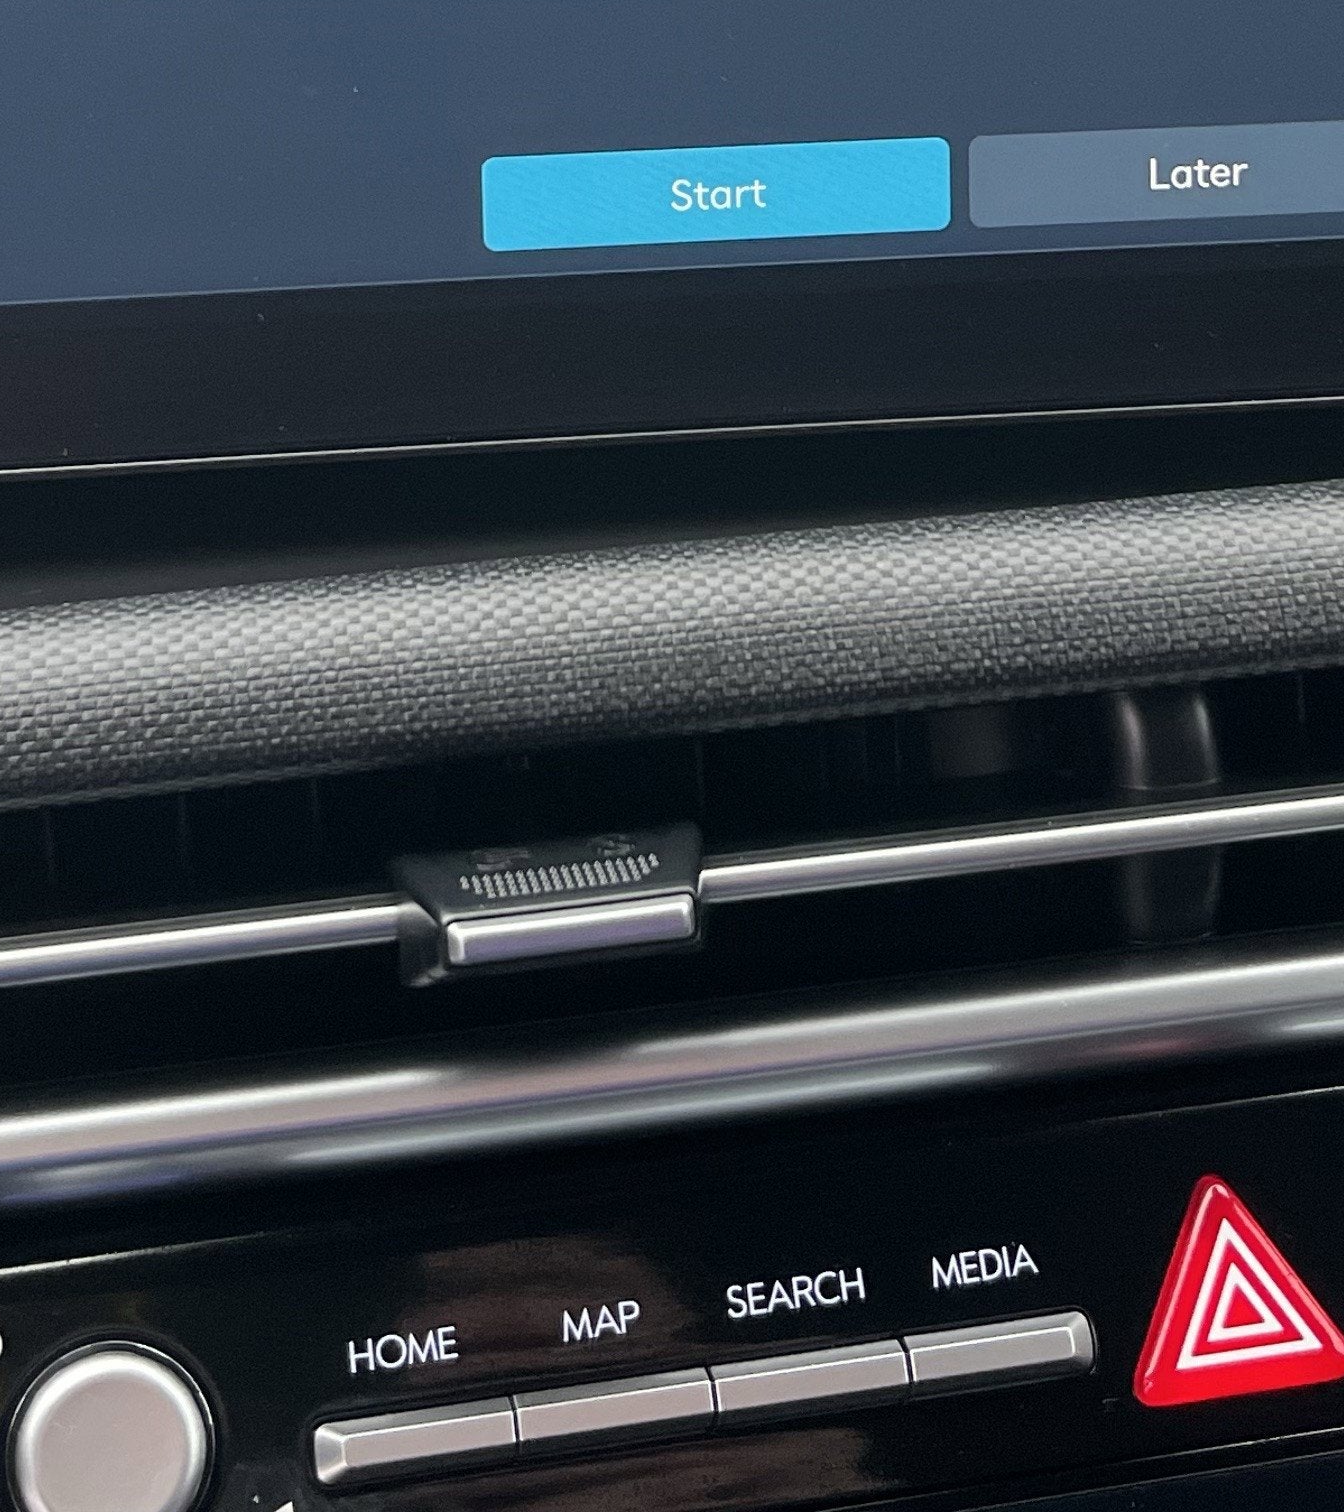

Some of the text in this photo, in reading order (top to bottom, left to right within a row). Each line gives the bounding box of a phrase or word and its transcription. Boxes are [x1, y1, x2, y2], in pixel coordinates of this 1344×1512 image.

[669, 177, 768, 214] Start
[1149, 156, 1250, 191] Later
[930, 1242, 1041, 1290] MEDIA
[725, 1266, 867, 1320] SEARCH
[561, 1299, 641, 1344] MAP
[347, 1324, 460, 1375] HOME
